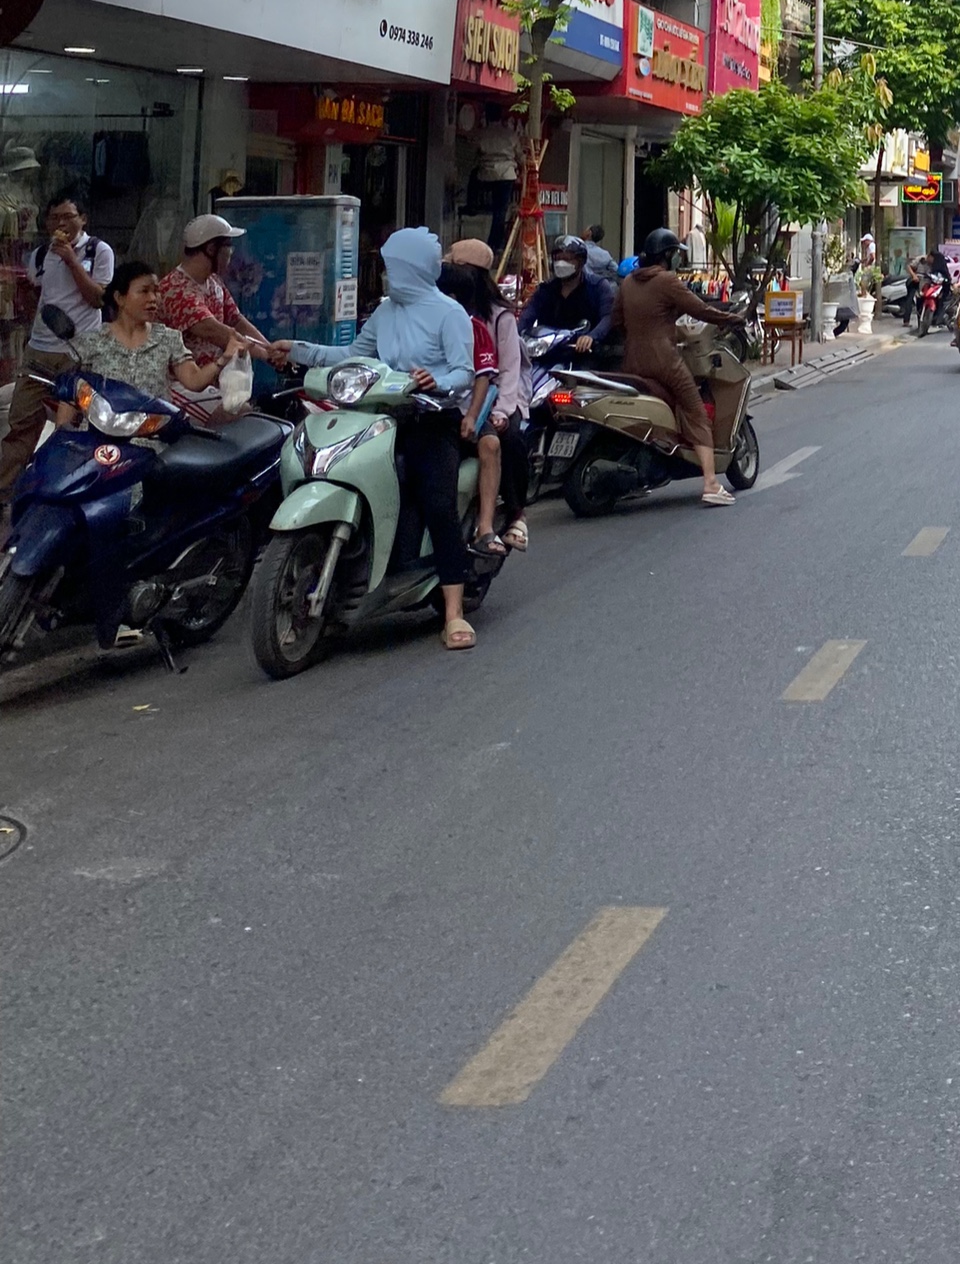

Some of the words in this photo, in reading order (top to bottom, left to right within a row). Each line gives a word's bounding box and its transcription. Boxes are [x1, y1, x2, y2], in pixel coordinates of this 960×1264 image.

[388, 24, 406, 43] 0974
[406, 29, 420, 46] 338
[420, 34, 433, 50] 246
